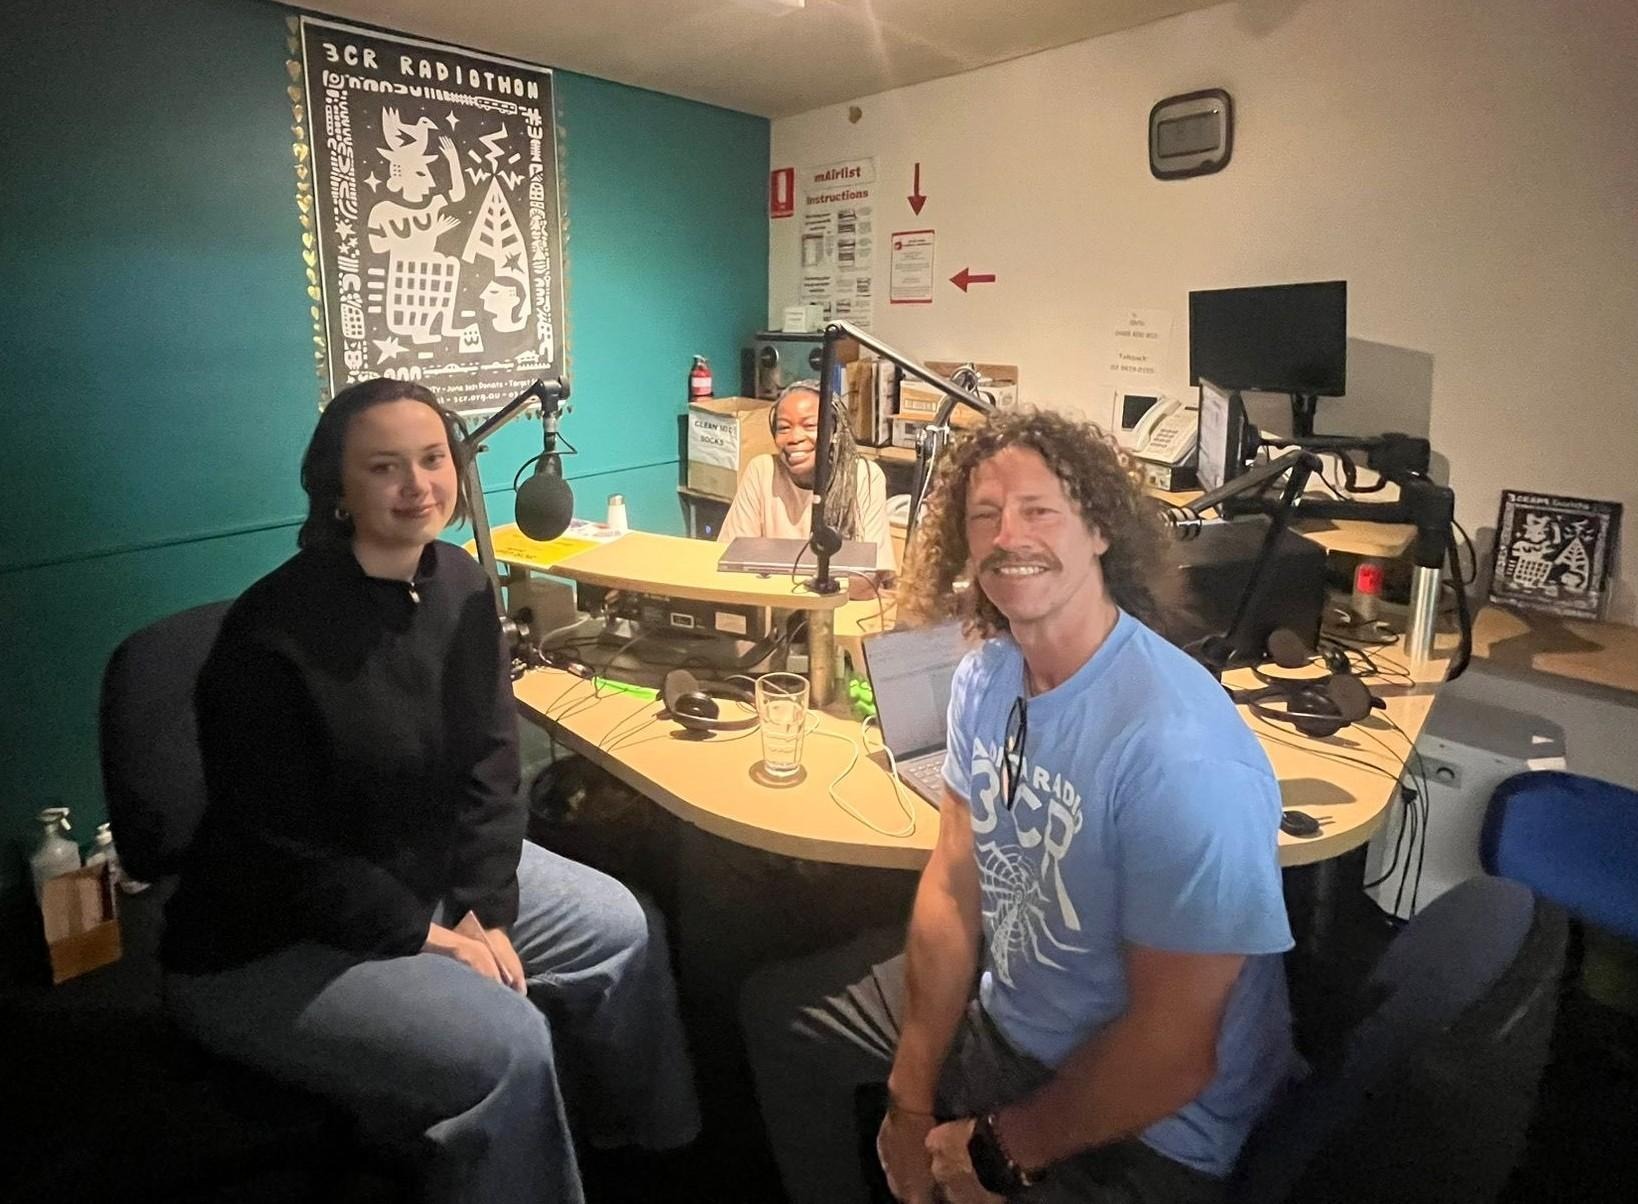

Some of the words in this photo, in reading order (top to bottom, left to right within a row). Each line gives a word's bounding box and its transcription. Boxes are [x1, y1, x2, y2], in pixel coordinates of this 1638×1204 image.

[322, 42, 379, 69] 3CR
[400, 56, 540, 100] RADIOTHON
[814, 166, 862, 183] mAirlist
[806, 189, 869, 205] Instructions
[694, 420, 718, 430] CLEAN
[700, 435, 724, 446] SOCKS
[1033, 765, 1083, 834] RADIO
[971, 759, 1082, 931] 3CR
